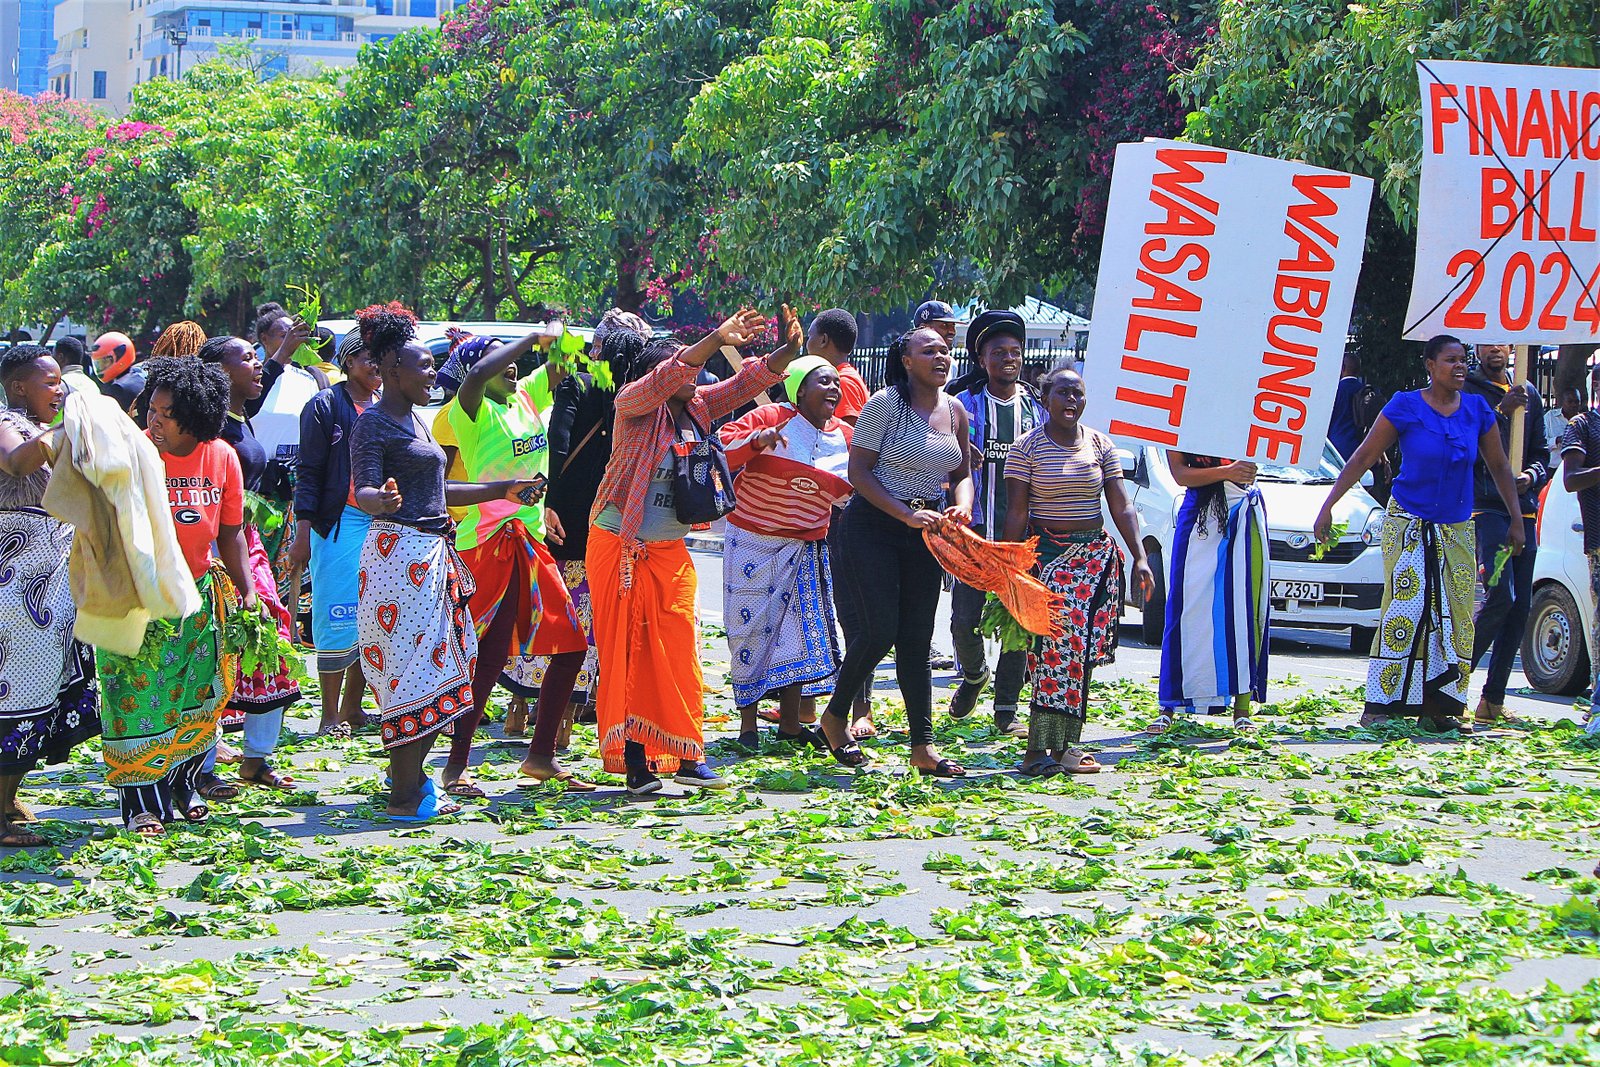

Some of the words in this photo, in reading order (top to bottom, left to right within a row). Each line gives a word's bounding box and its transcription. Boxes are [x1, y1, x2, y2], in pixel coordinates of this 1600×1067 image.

[1480, 167, 1597, 242] BILL
[1108, 148, 1228, 447] WASALITI
[1246, 174, 1352, 465] WABUNGE
[1284, 582, 1320, 599] 239J
